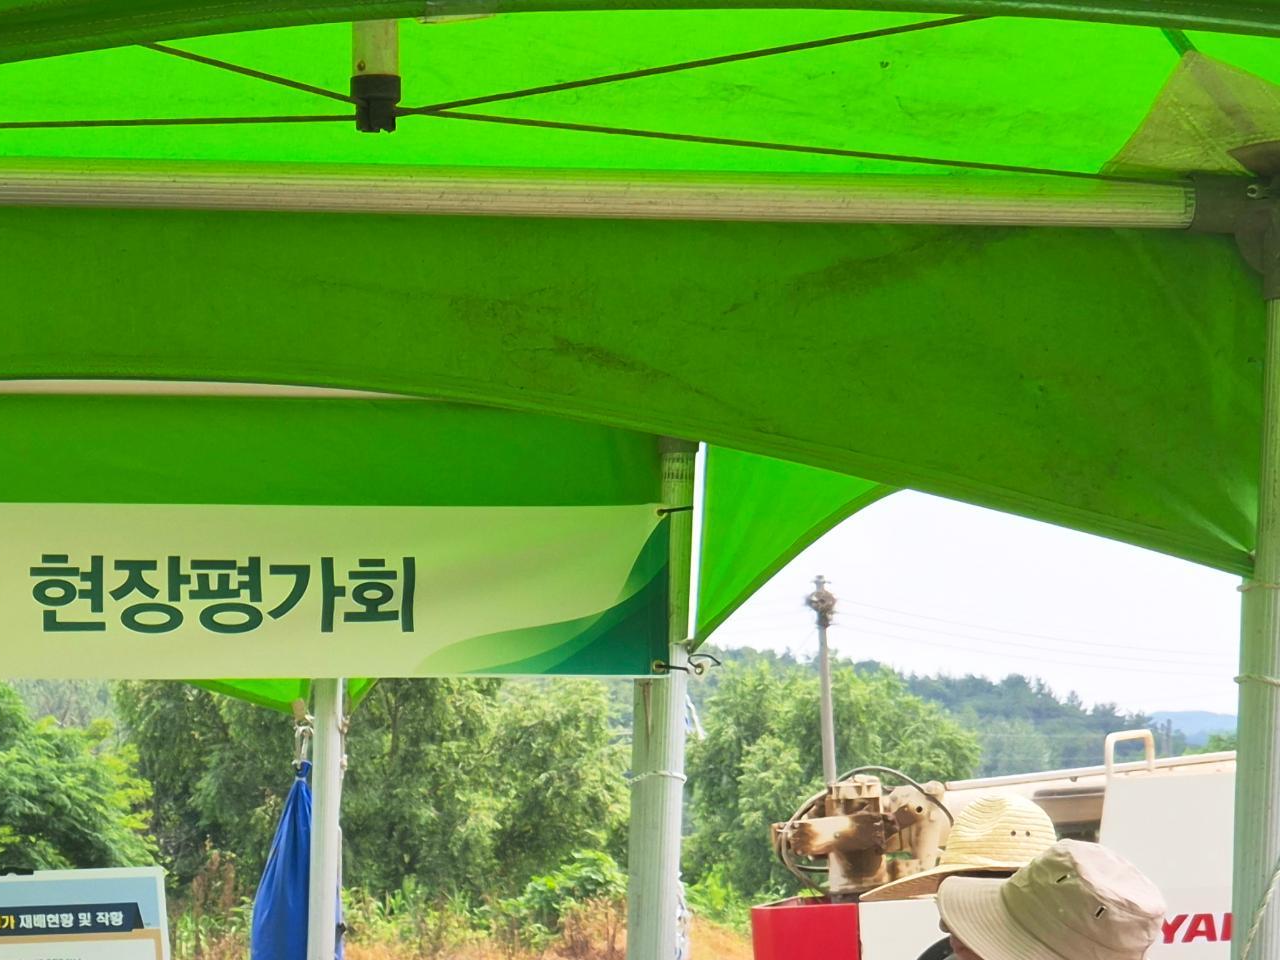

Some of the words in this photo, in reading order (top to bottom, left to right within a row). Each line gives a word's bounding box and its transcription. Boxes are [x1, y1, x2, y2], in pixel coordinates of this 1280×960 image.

[30, 554, 415, 634] 현장평가회
[19, 913, 74, 929] 재배현황
[78, 912, 92, 927] 및
[96, 911, 123, 926] 작황
